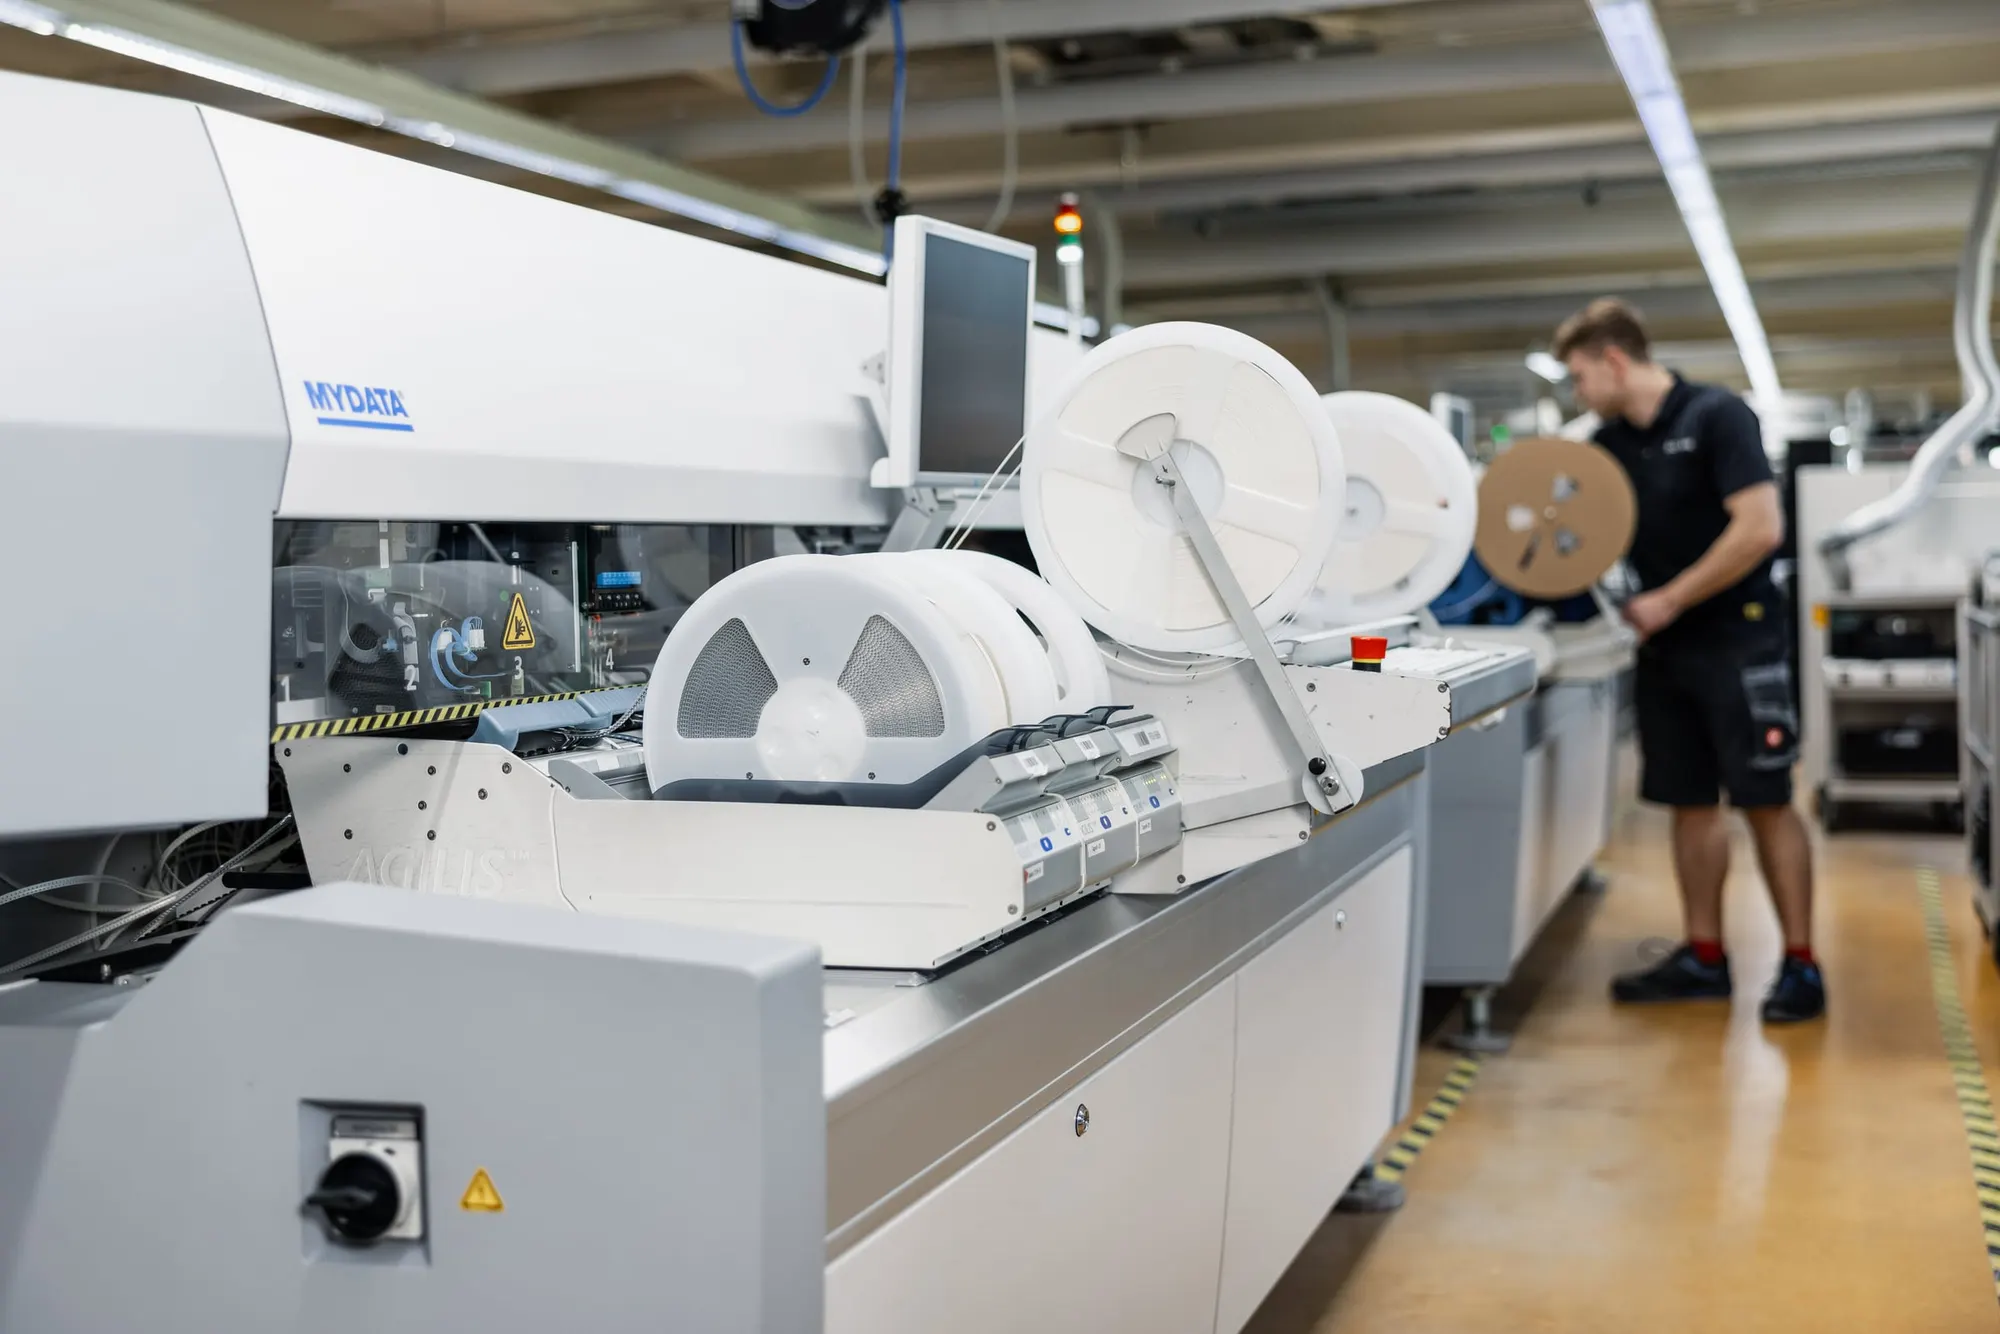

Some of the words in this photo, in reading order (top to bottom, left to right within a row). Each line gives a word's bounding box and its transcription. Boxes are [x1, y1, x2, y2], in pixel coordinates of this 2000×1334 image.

[303, 380, 410, 418] MYDATA
[514, 655, 523, 680] 3
[605, 648, 615, 670] 4
[281, 675, 291, 702] 1
[405, 664, 417, 691] 2
